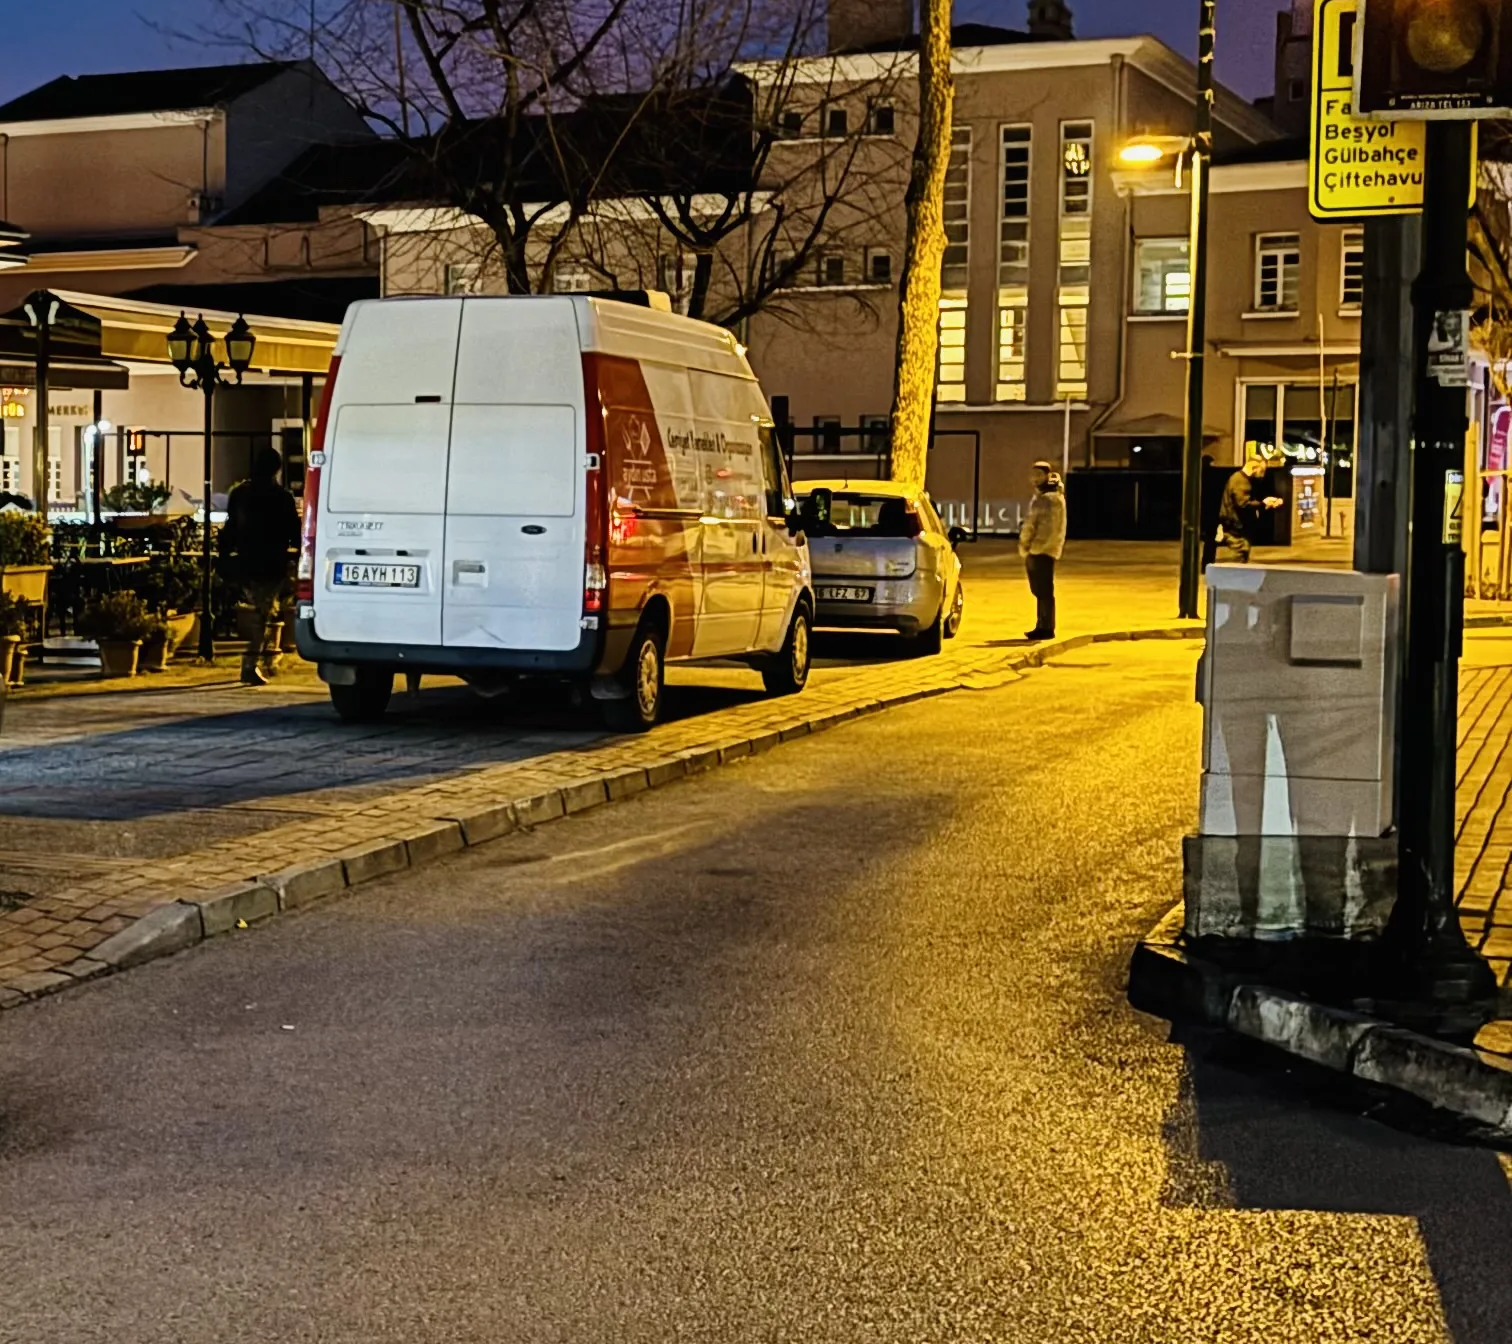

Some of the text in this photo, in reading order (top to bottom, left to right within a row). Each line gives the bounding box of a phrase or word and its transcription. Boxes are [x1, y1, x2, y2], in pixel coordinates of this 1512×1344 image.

[1325, 99, 1352, 116] Fa
[1325, 121, 1395, 143] Beşyol
[1324, 145, 1419, 166] Gülbahçe
[1324, 170, 1423, 193] Çiftehavu
[344, 565, 415, 583] 16 AYH 113
